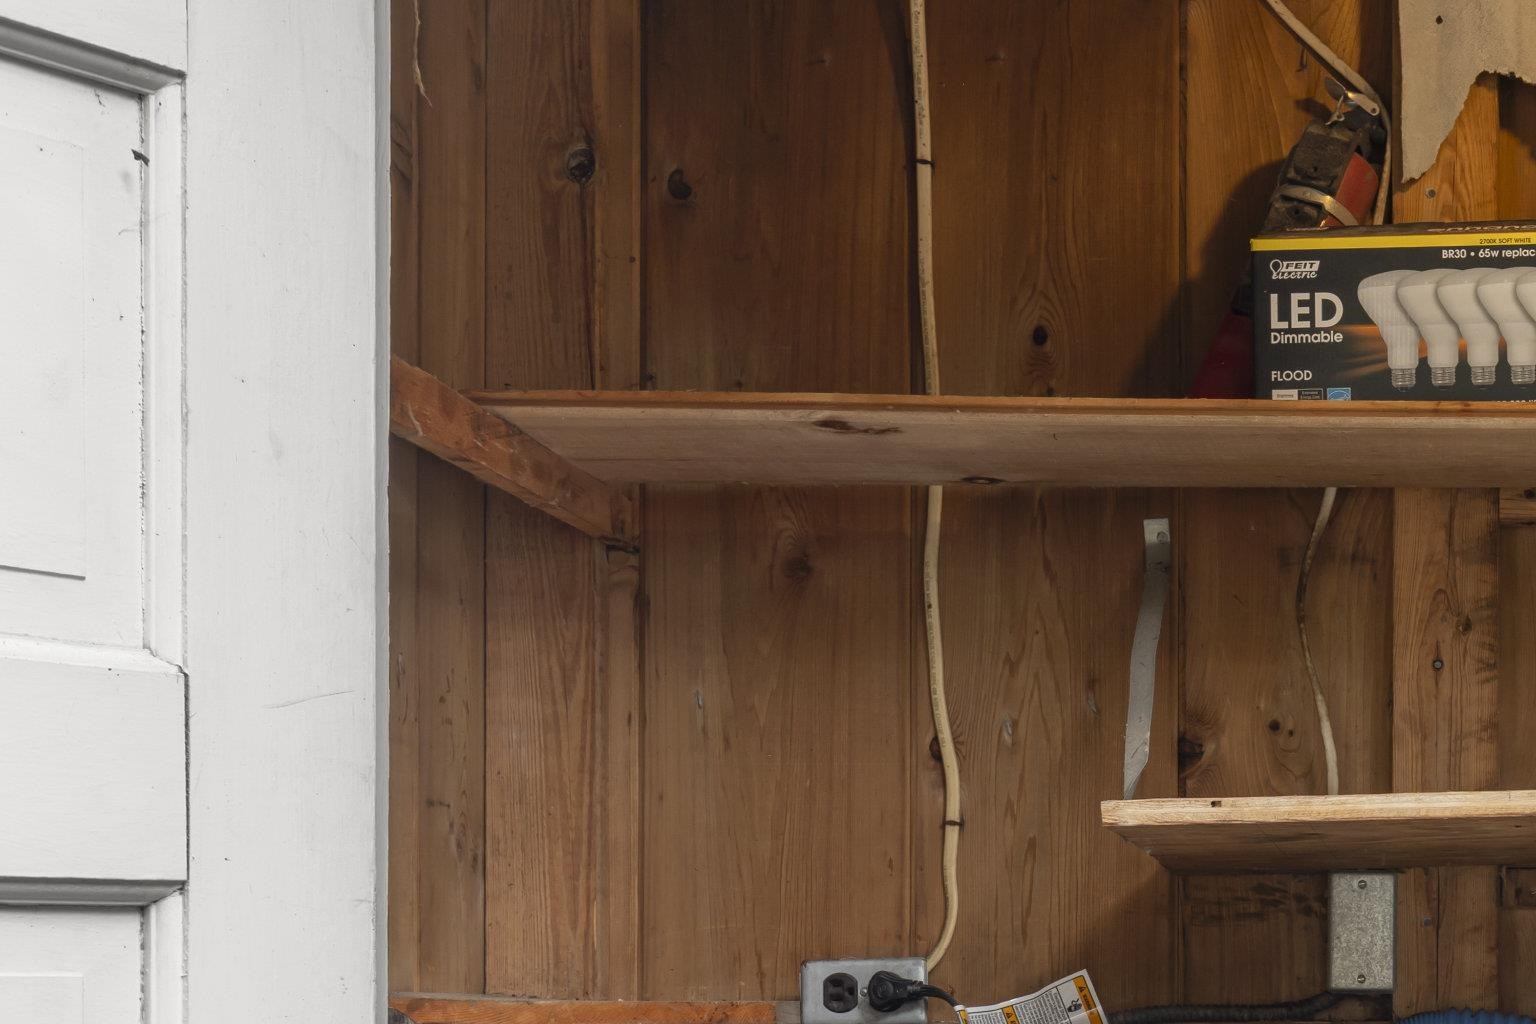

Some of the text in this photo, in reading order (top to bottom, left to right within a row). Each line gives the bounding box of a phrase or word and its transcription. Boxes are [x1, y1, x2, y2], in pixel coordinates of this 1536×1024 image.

[1441, 249, 1467, 259] BR30
[1478, 248, 1500, 258] 65w
[1283, 261, 1319, 271] FEIT
[1269, 291, 1344, 329] LED
[1270, 330, 1344, 345] Dimmable
[1271, 370, 1313, 382] FLOOD
